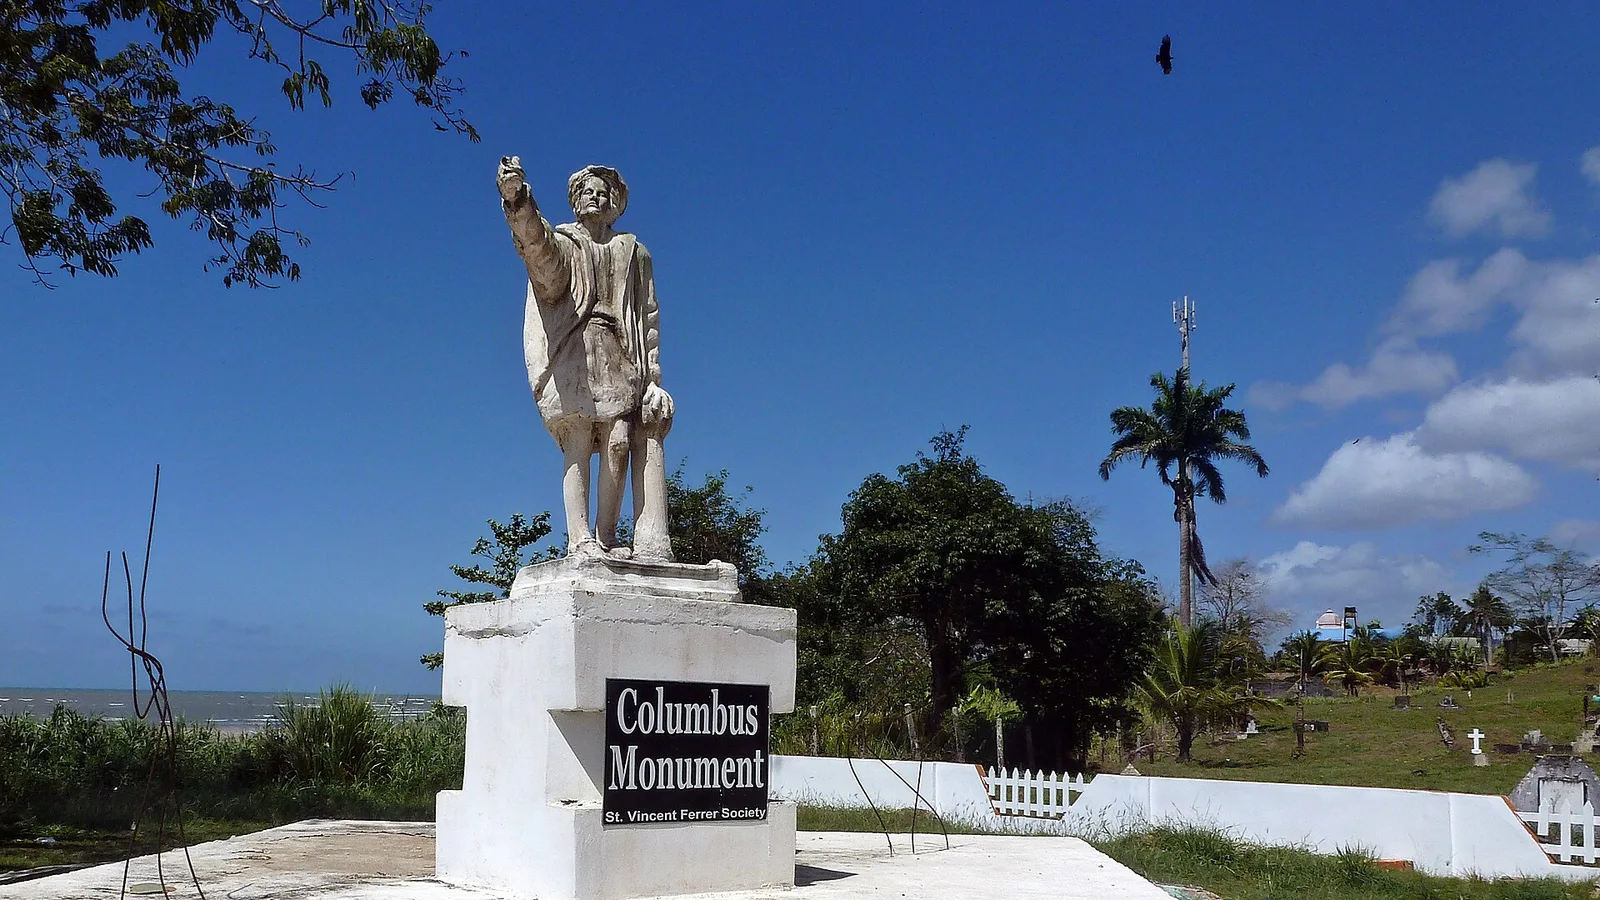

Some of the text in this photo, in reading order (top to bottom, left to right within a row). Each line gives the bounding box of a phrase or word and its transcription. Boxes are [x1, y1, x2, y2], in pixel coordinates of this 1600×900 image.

[617, 686, 759, 736] Columbus
[608, 745, 765, 790] Monument
[605, 807, 766, 823] St. Vincent Ferrer Society
